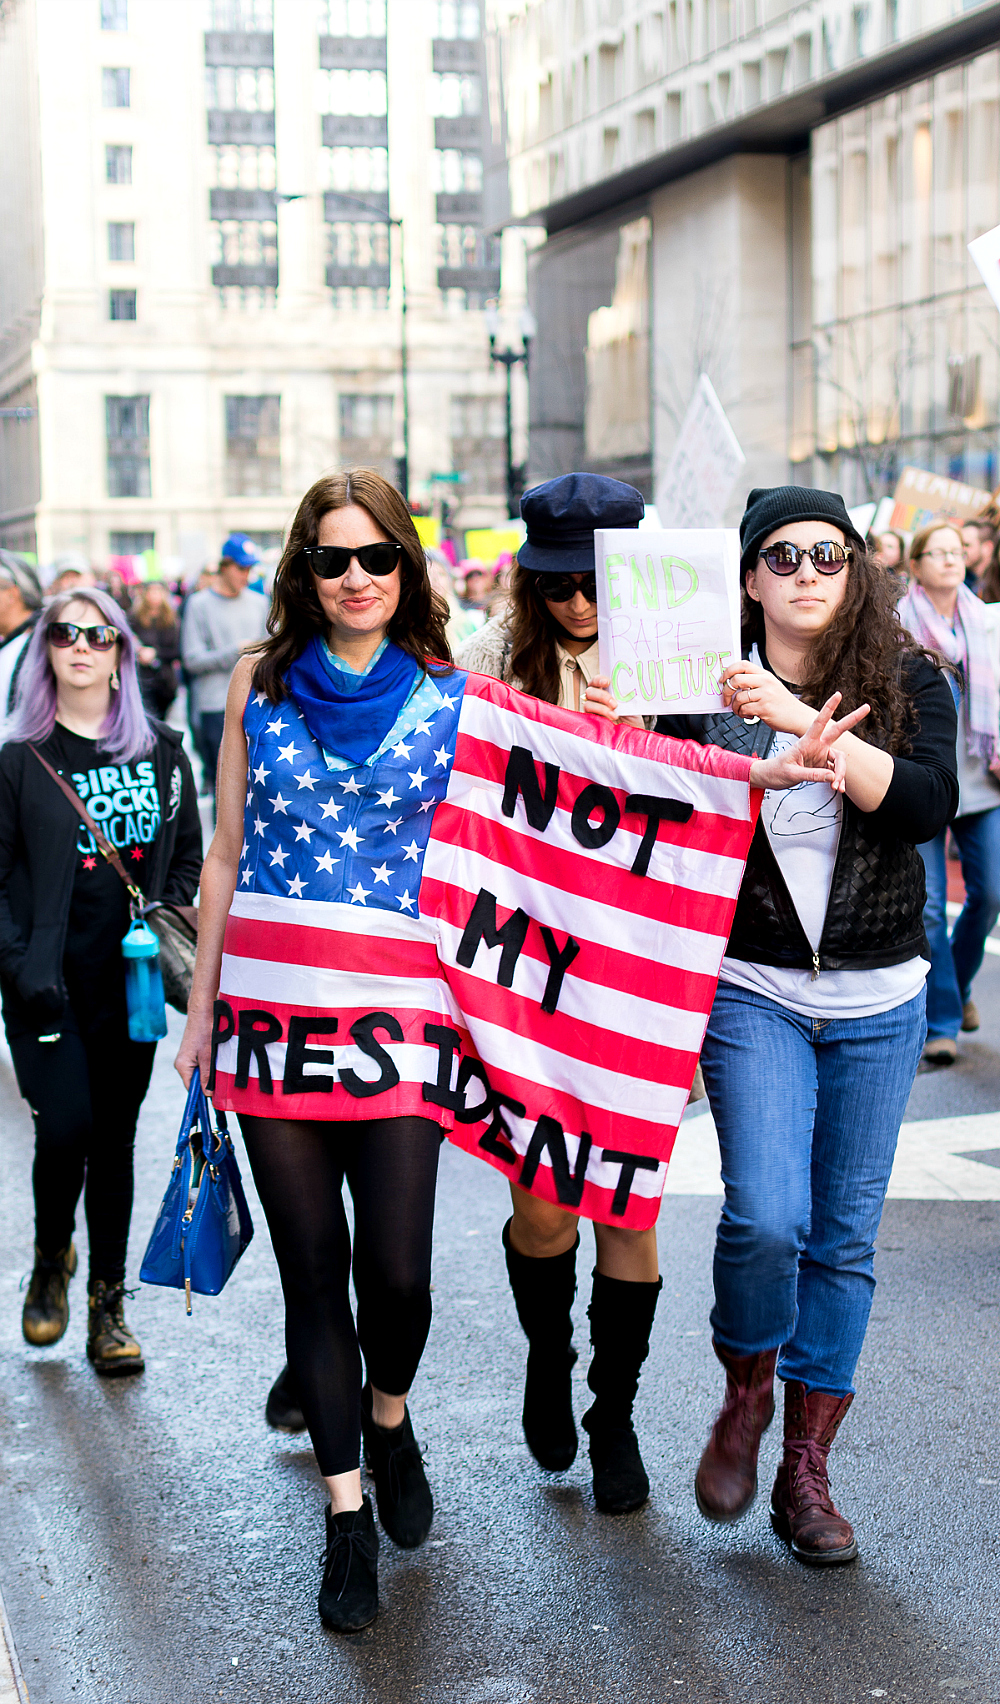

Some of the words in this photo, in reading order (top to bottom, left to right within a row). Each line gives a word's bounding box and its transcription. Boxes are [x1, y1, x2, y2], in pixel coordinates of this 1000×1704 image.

[605, 553, 700, 611] END
[609, 615, 706, 658] RAPE
[611, 651, 732, 702] CULTURE
[85, 786, 161, 821] OCK!
[500, 744, 694, 877] NOT
[455, 887, 581, 1015] MY
[208, 999, 660, 1217] PRESIDENT
